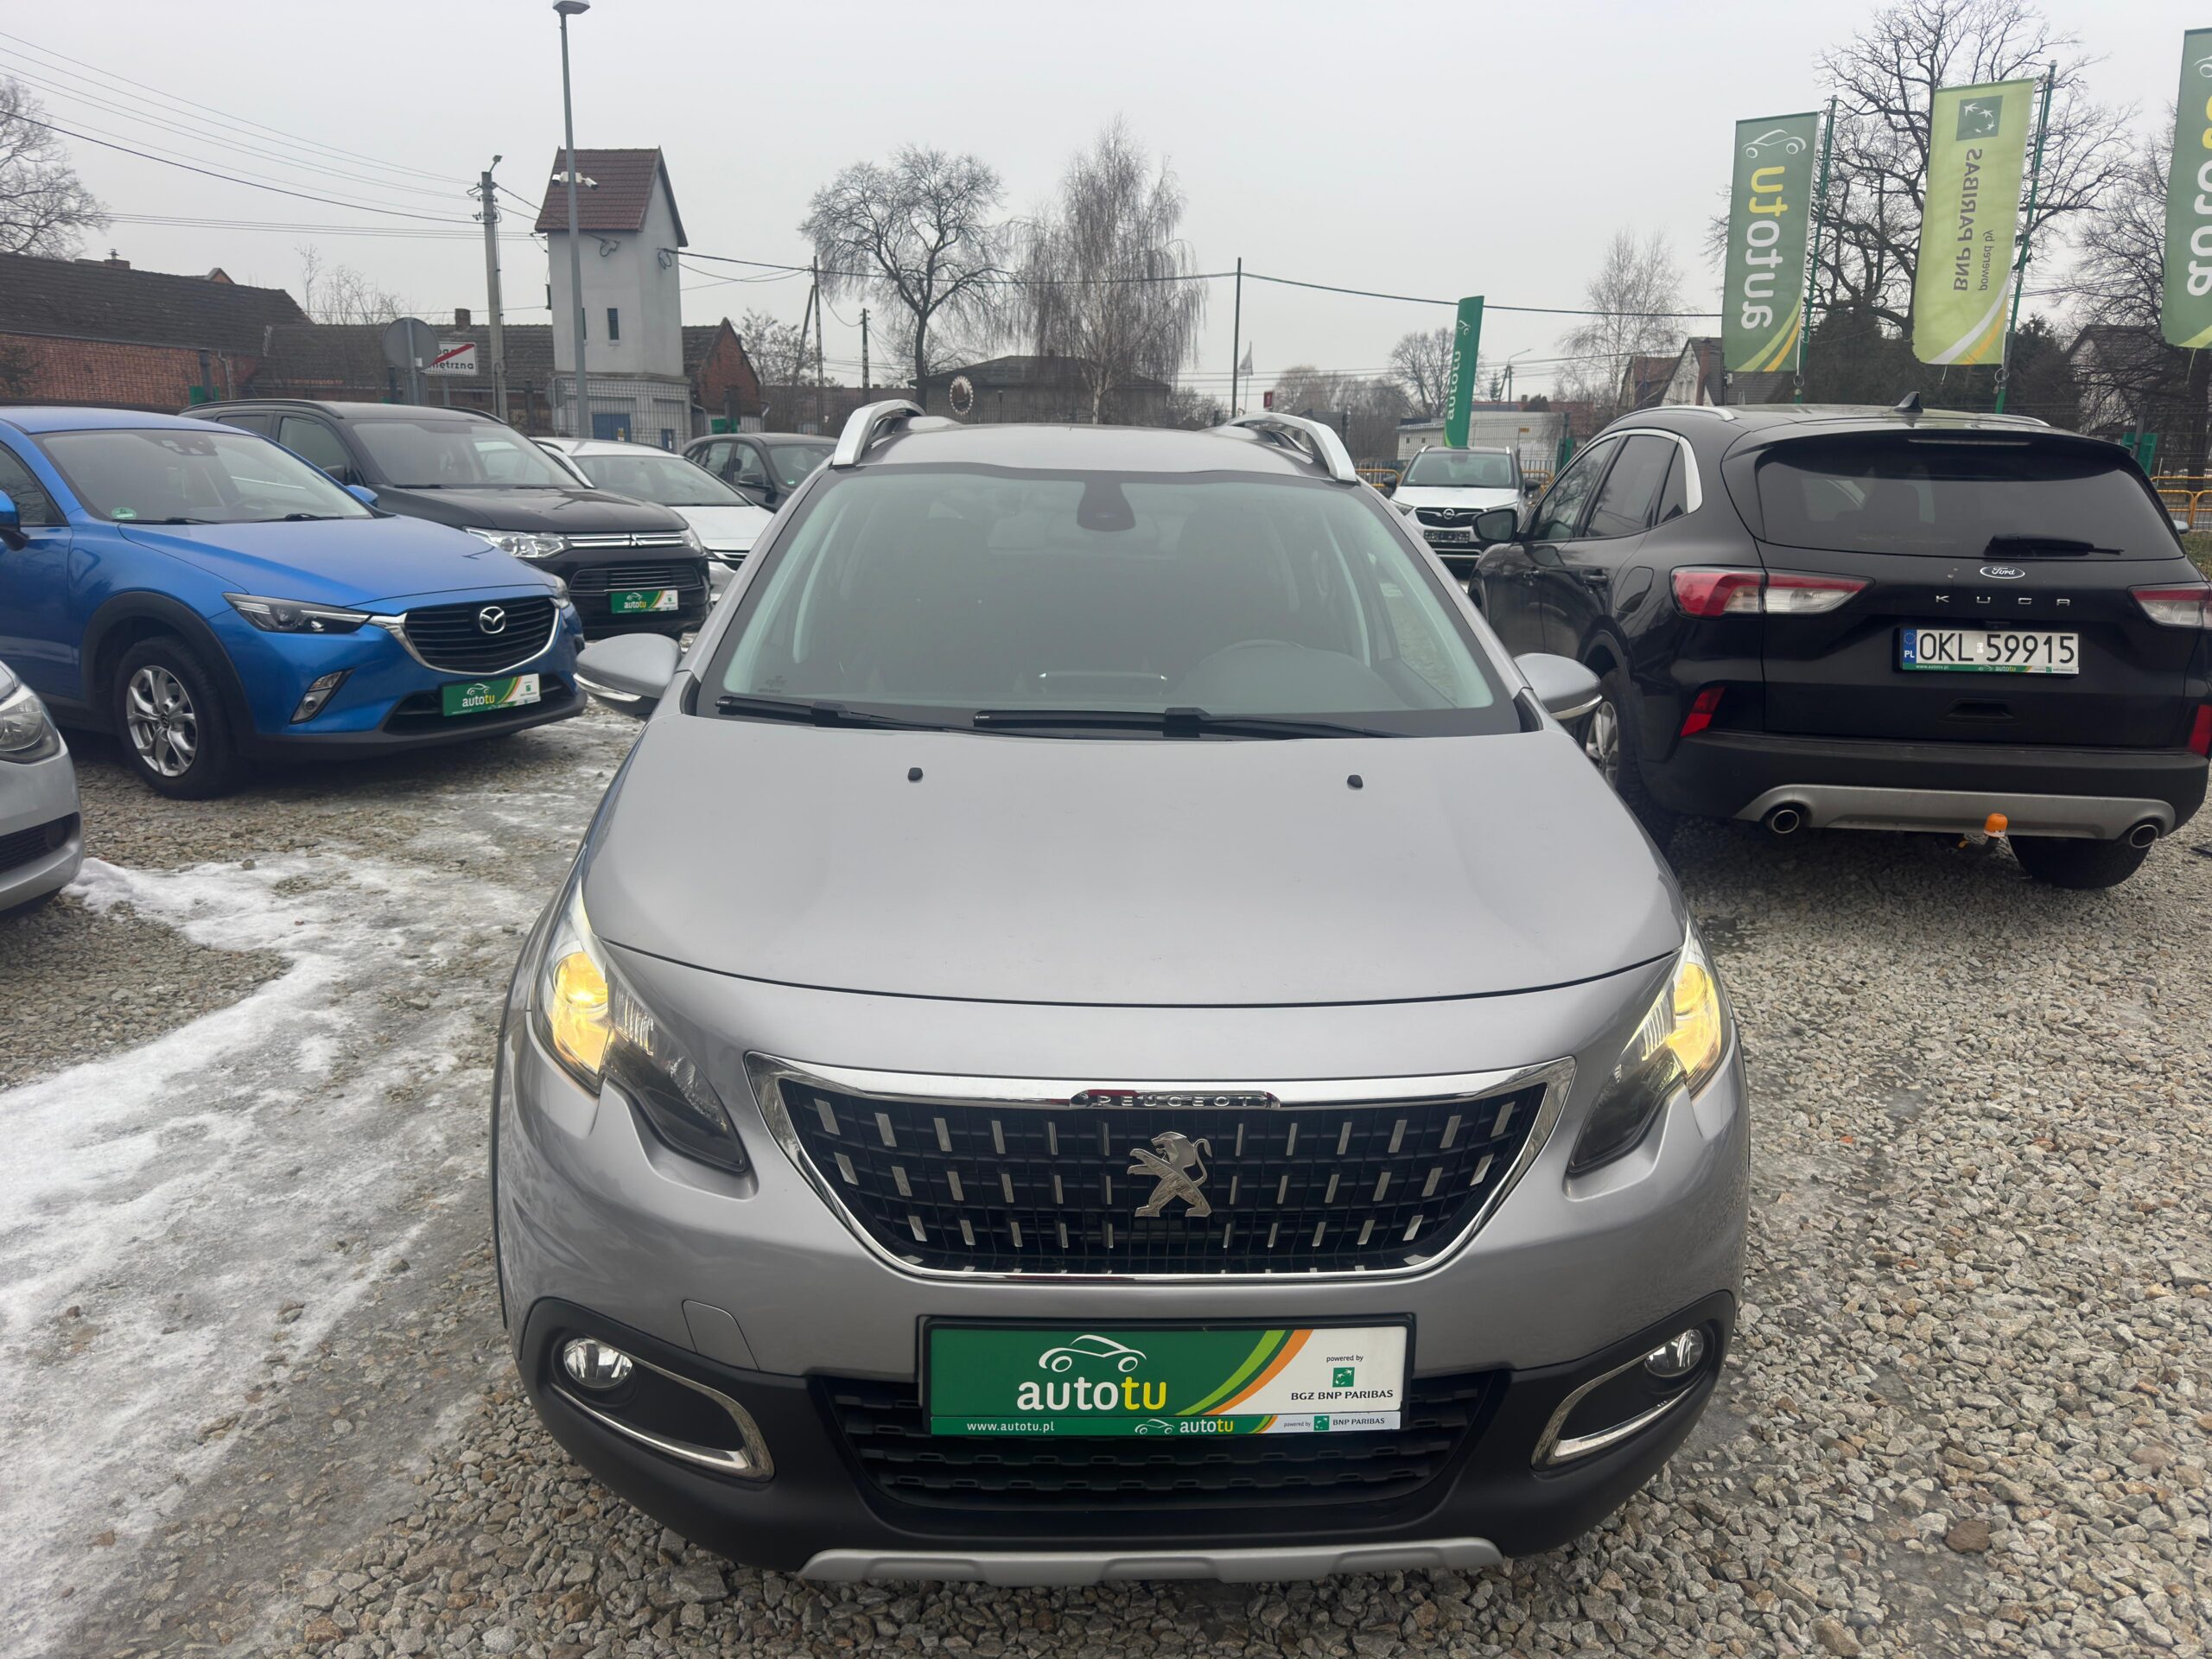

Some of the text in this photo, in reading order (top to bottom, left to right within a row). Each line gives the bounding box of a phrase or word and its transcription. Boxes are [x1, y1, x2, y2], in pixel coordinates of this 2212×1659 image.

[1447, 351, 1461, 420] autotu
[1991, 567, 2016, 575] Ford
[1936, 594, 2070, 606] KUGA
[1904, 650, 1915, 658] PL
[1919, 632, 2075, 664] OKL 59915
[462, 695, 495, 708] autotu
[1096, 1096, 1249, 1107] PEUGEOT
[1017, 1376, 1166, 1410] autotu
[1318, 1391, 1342, 1400] BNP
[1344, 1389, 1394, 1399] PARIBAS
[967, 1421, 1055, 1433] www.autotu.pl
[1179, 1419, 1234, 1433] autotu
